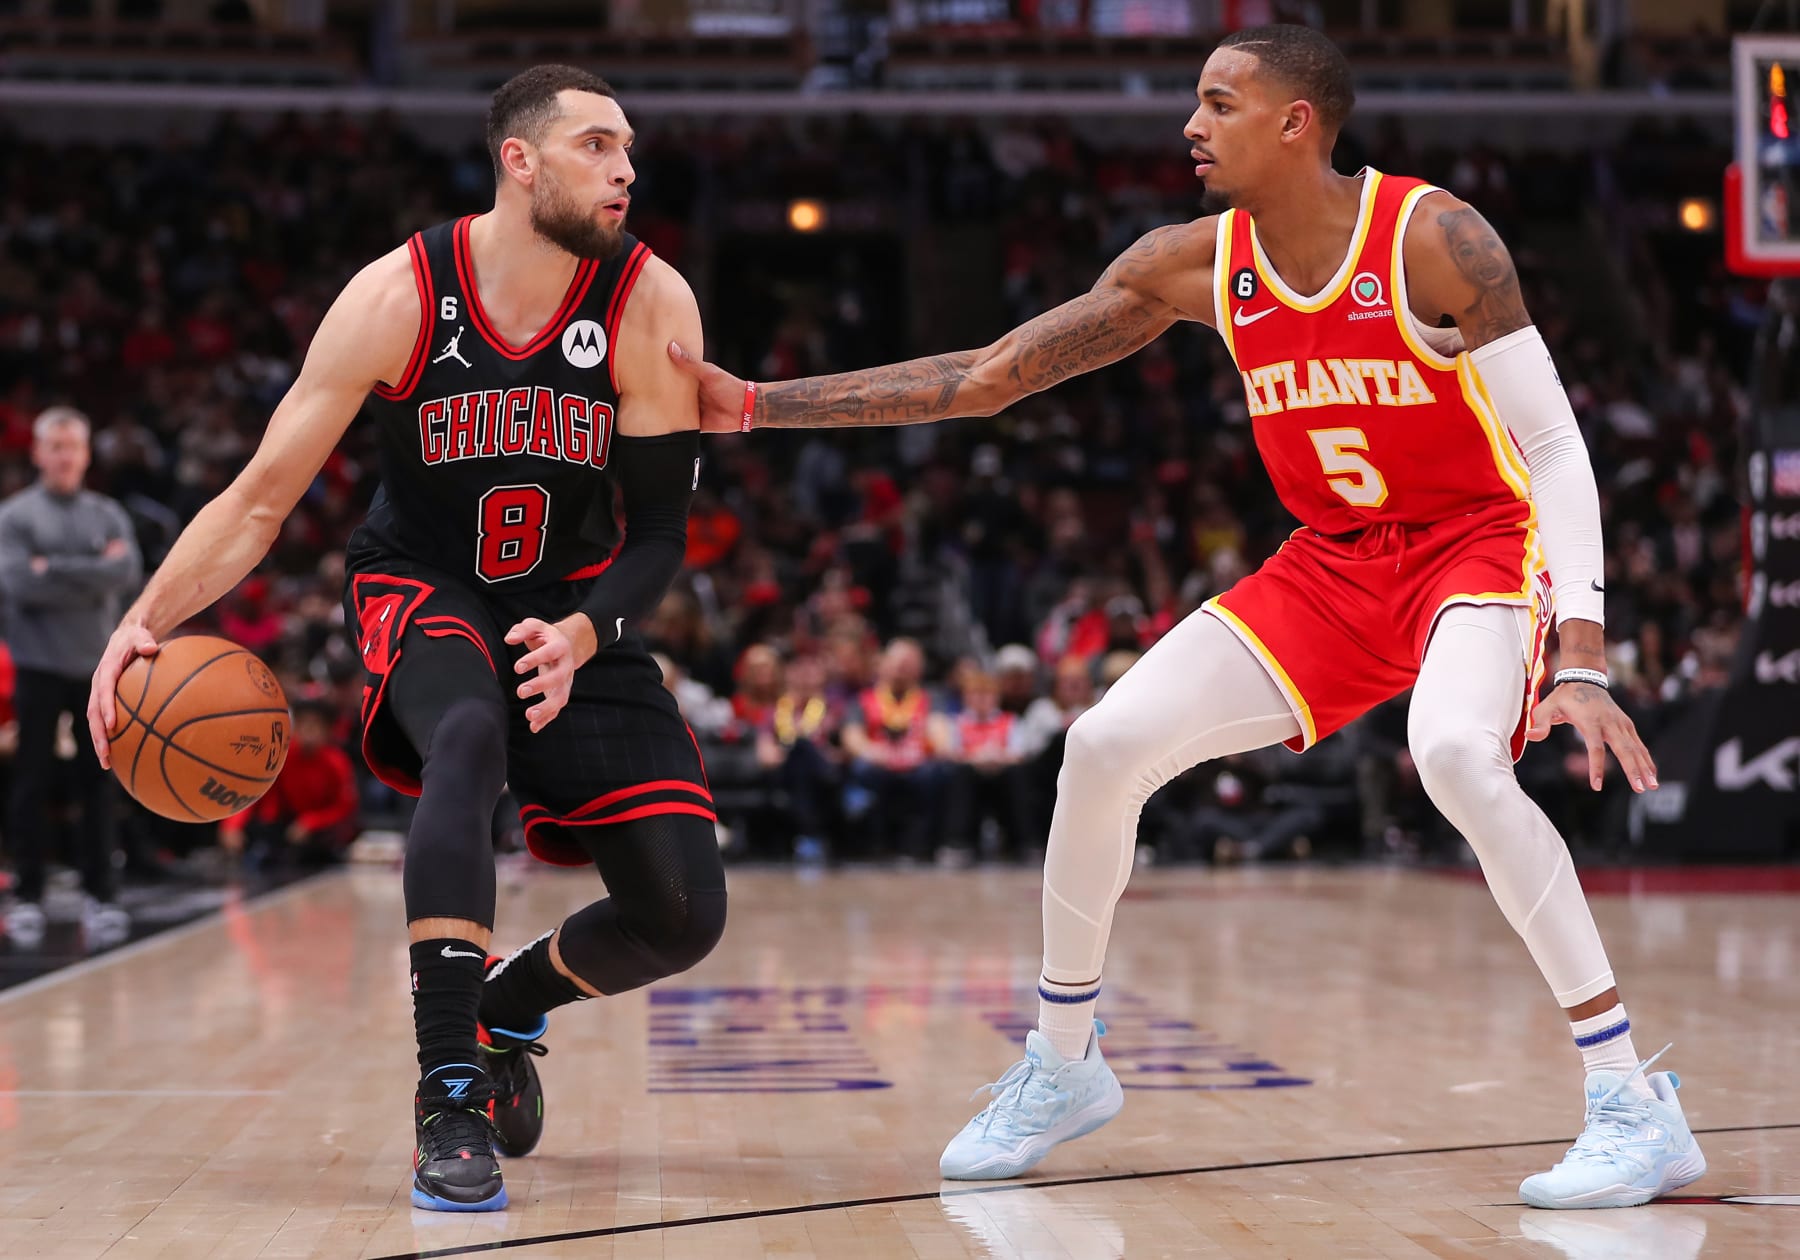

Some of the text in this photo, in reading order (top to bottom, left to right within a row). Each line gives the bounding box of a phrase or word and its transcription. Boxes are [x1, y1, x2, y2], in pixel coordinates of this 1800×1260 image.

[440, 296, 458, 320] 6
[1237, 272, 1252, 297] 6
[1347, 309, 1393, 321] sharecare
[1241, 359, 1437, 417] ATLANTA
[418, 386, 614, 470] CHICAGO
[1306, 427, 1389, 507] 5
[476, 484, 550, 584] 8
